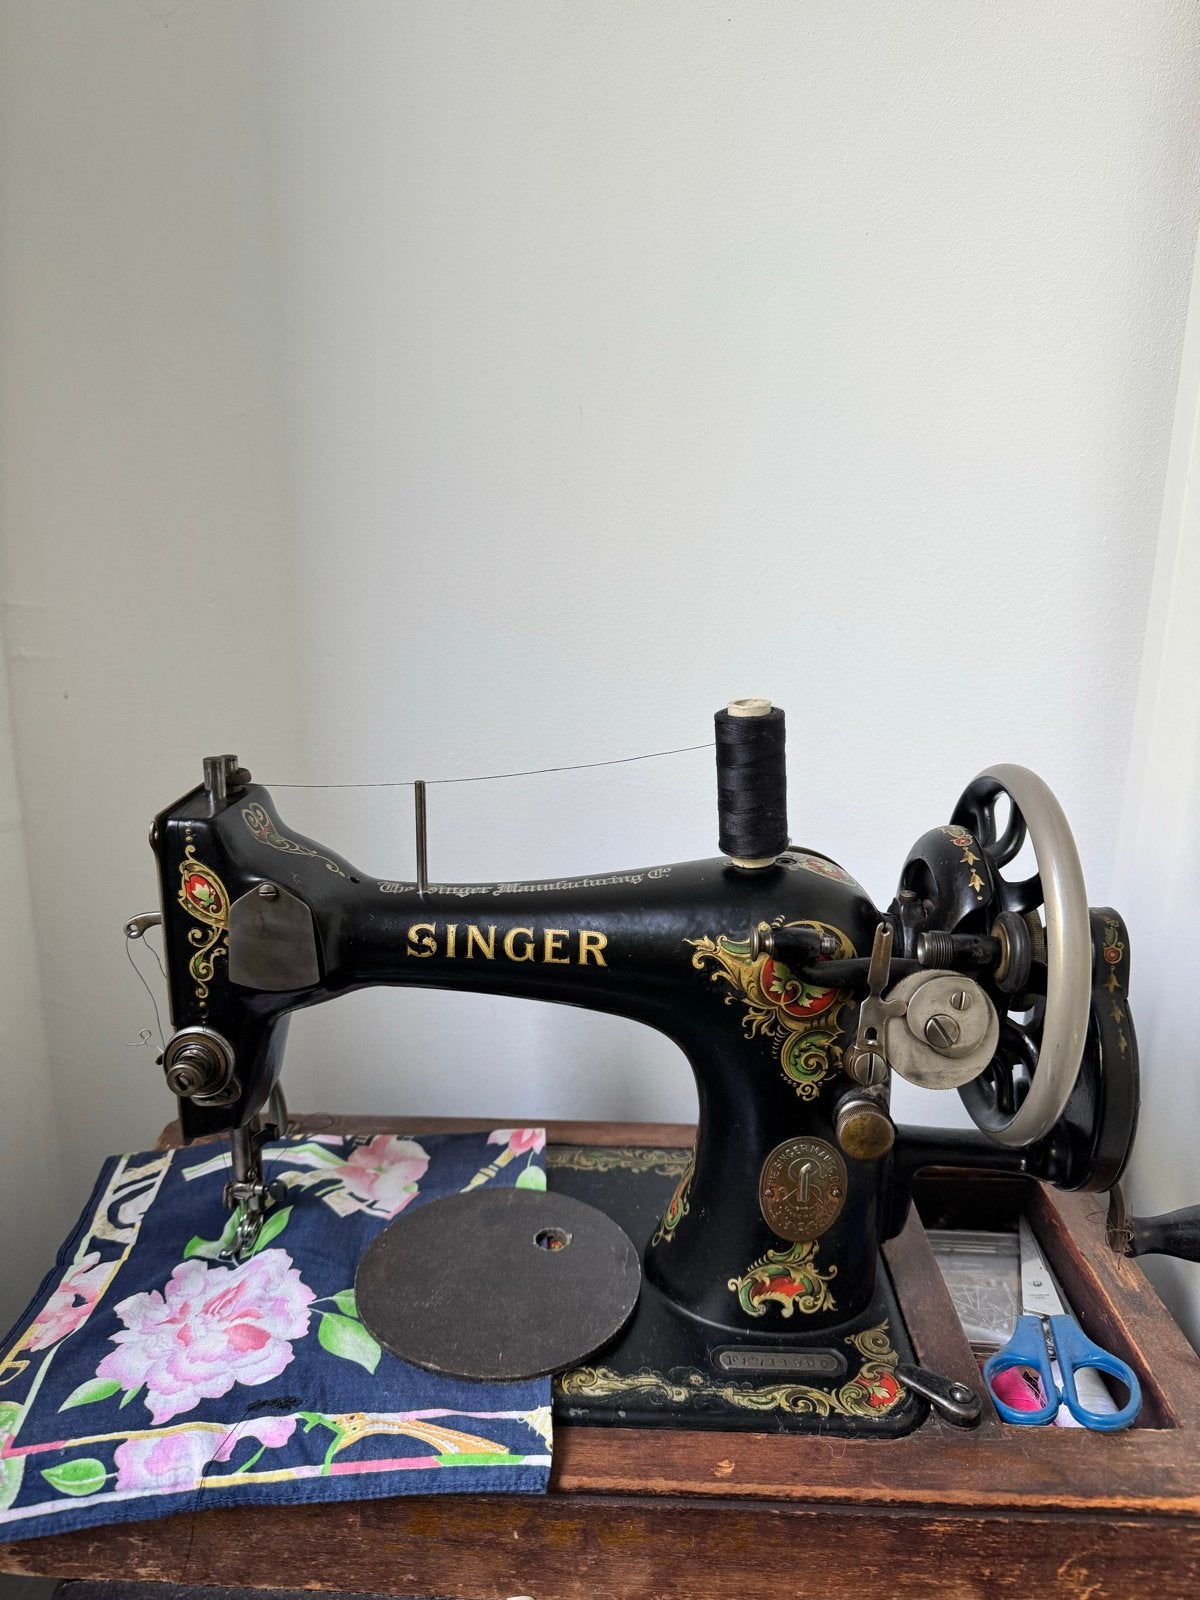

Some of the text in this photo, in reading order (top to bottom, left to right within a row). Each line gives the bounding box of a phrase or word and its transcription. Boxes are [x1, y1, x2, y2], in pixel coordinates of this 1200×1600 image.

[377, 881, 416, 894] The
[493, 873, 645, 896] Manufacturing
[406, 922, 608, 967] SINGER
